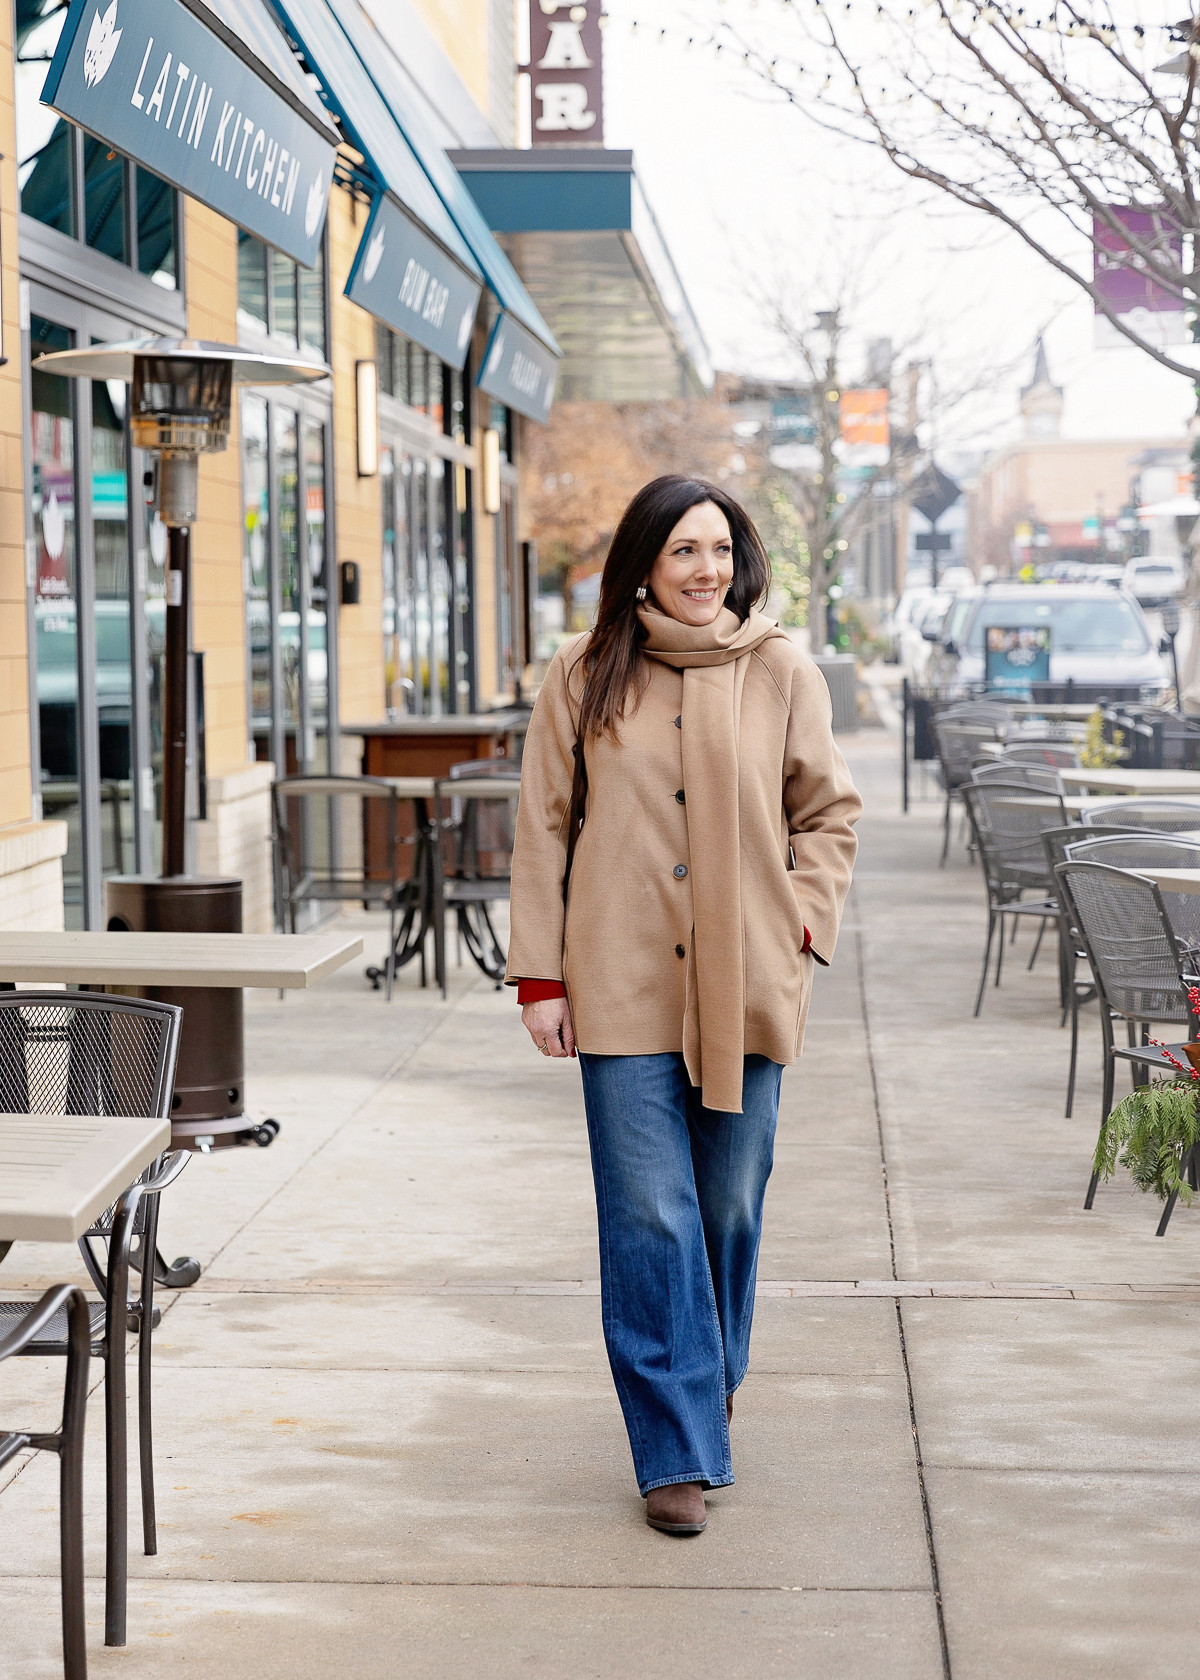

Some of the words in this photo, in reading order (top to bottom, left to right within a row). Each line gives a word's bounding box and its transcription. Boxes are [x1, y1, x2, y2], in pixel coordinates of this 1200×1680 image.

[130, 37, 213, 150] LATIN
[210, 100, 301, 216] KITCHEN
[535, 0, 597, 131] AR
[397, 257, 429, 314] RUM
[421, 276, 450, 330] BAR
